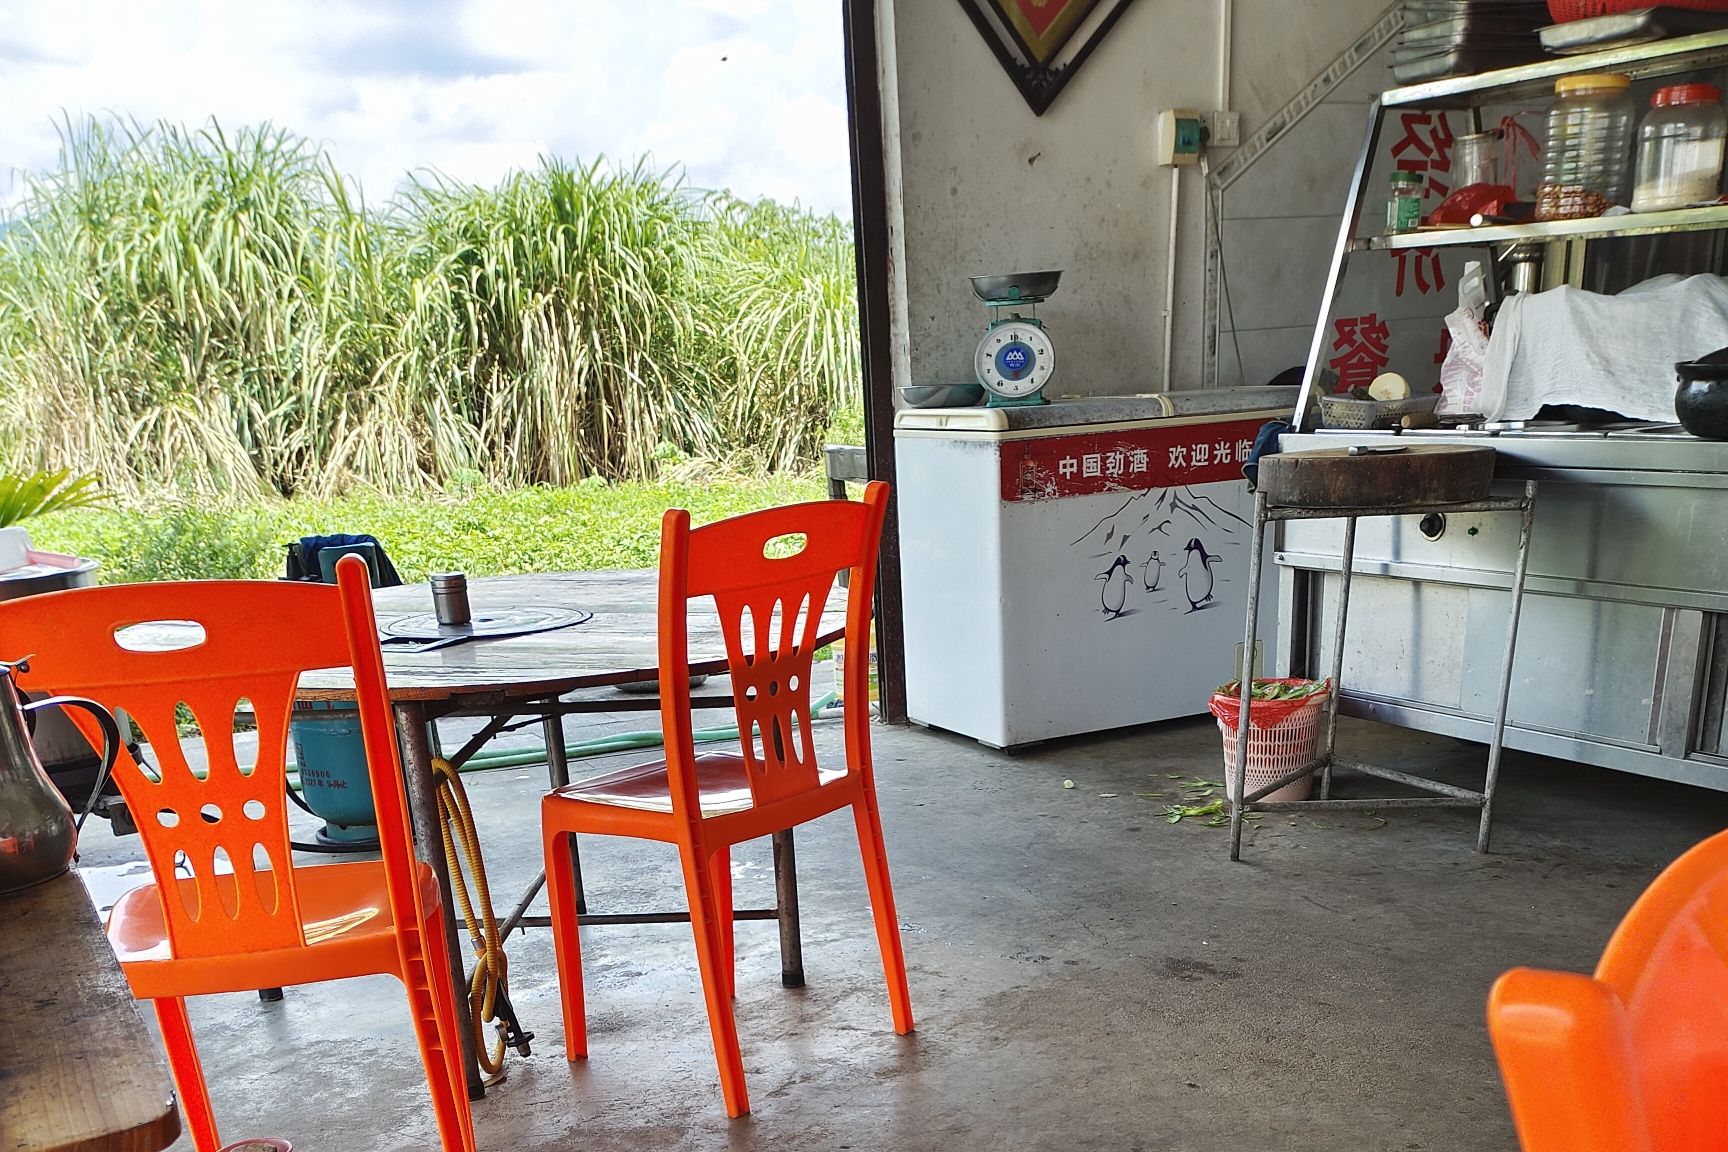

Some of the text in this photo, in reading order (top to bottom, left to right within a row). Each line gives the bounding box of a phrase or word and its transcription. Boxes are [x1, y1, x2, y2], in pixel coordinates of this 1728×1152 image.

[1058, 439, 1253, 480] 中国劲酒 欢迎光临
